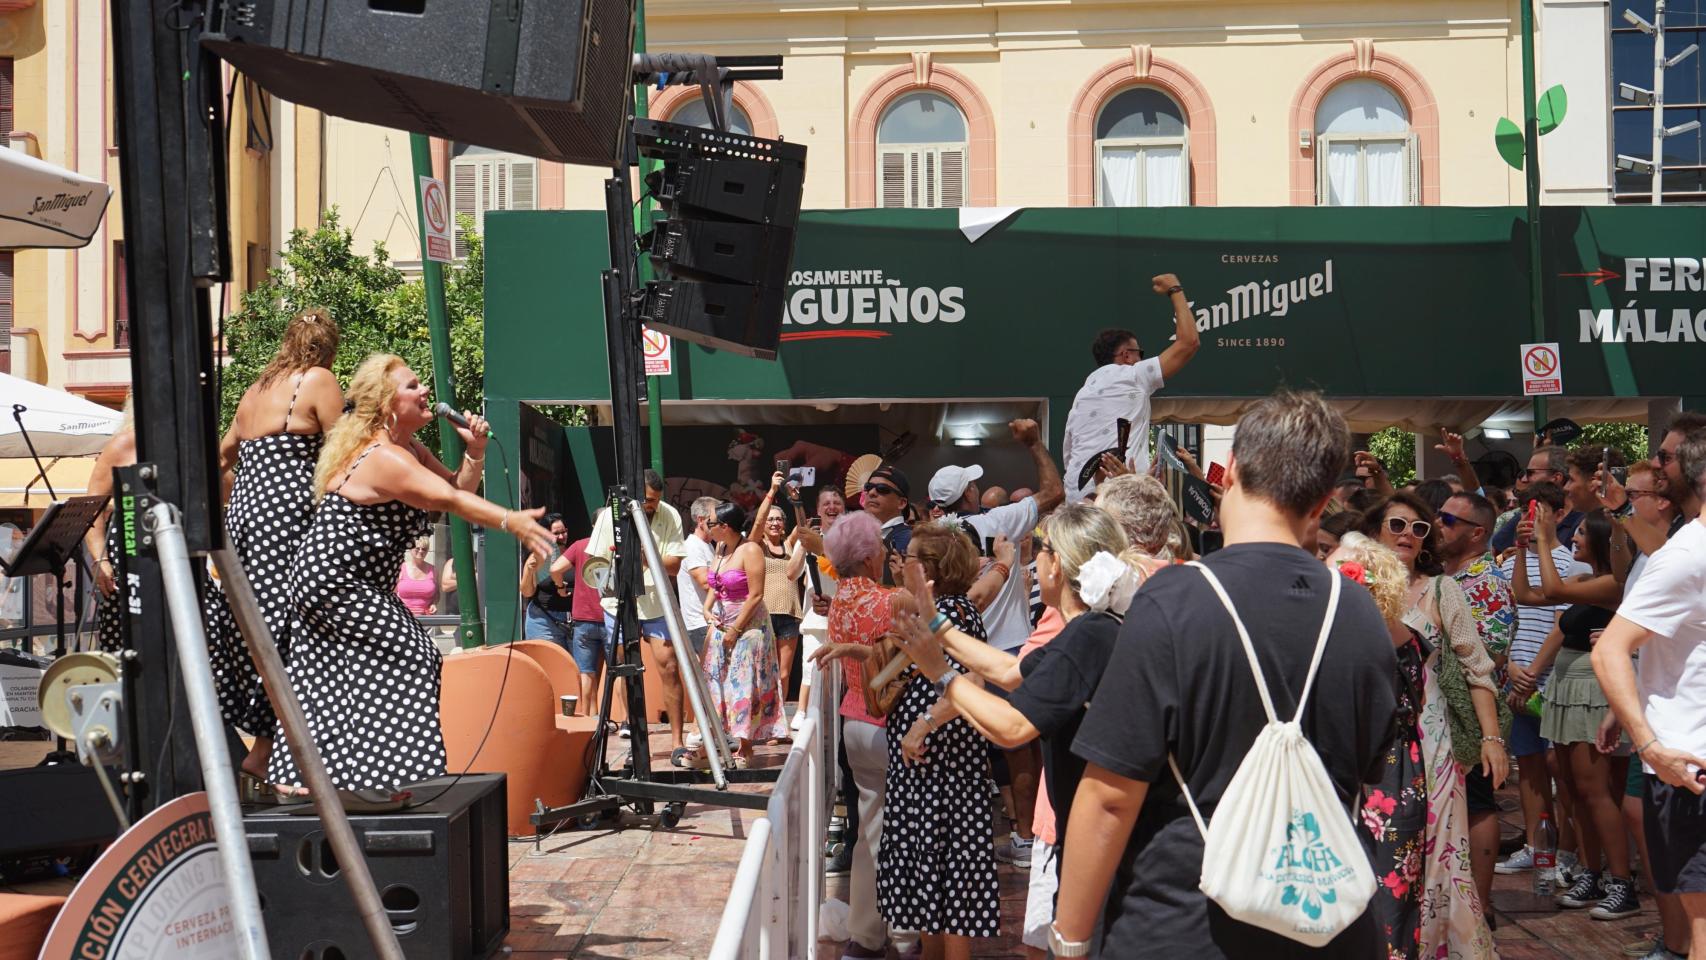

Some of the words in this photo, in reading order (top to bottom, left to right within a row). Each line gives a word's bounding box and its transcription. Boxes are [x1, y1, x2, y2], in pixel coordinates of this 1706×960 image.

[27, 190, 93, 216] SanMiguel
[788, 270, 883, 286] OSAMENTE
[1168, 259, 1333, 341] anMiguel
[1256, 337, 1285, 347] 1890
[123, 511, 137, 557] kuzar
[76, 898, 126, 960] CIÓN
[117, 818, 207, 900] CERVECERA
[164, 911, 217, 936] CERVEZA
[219, 905, 231, 920] PR
